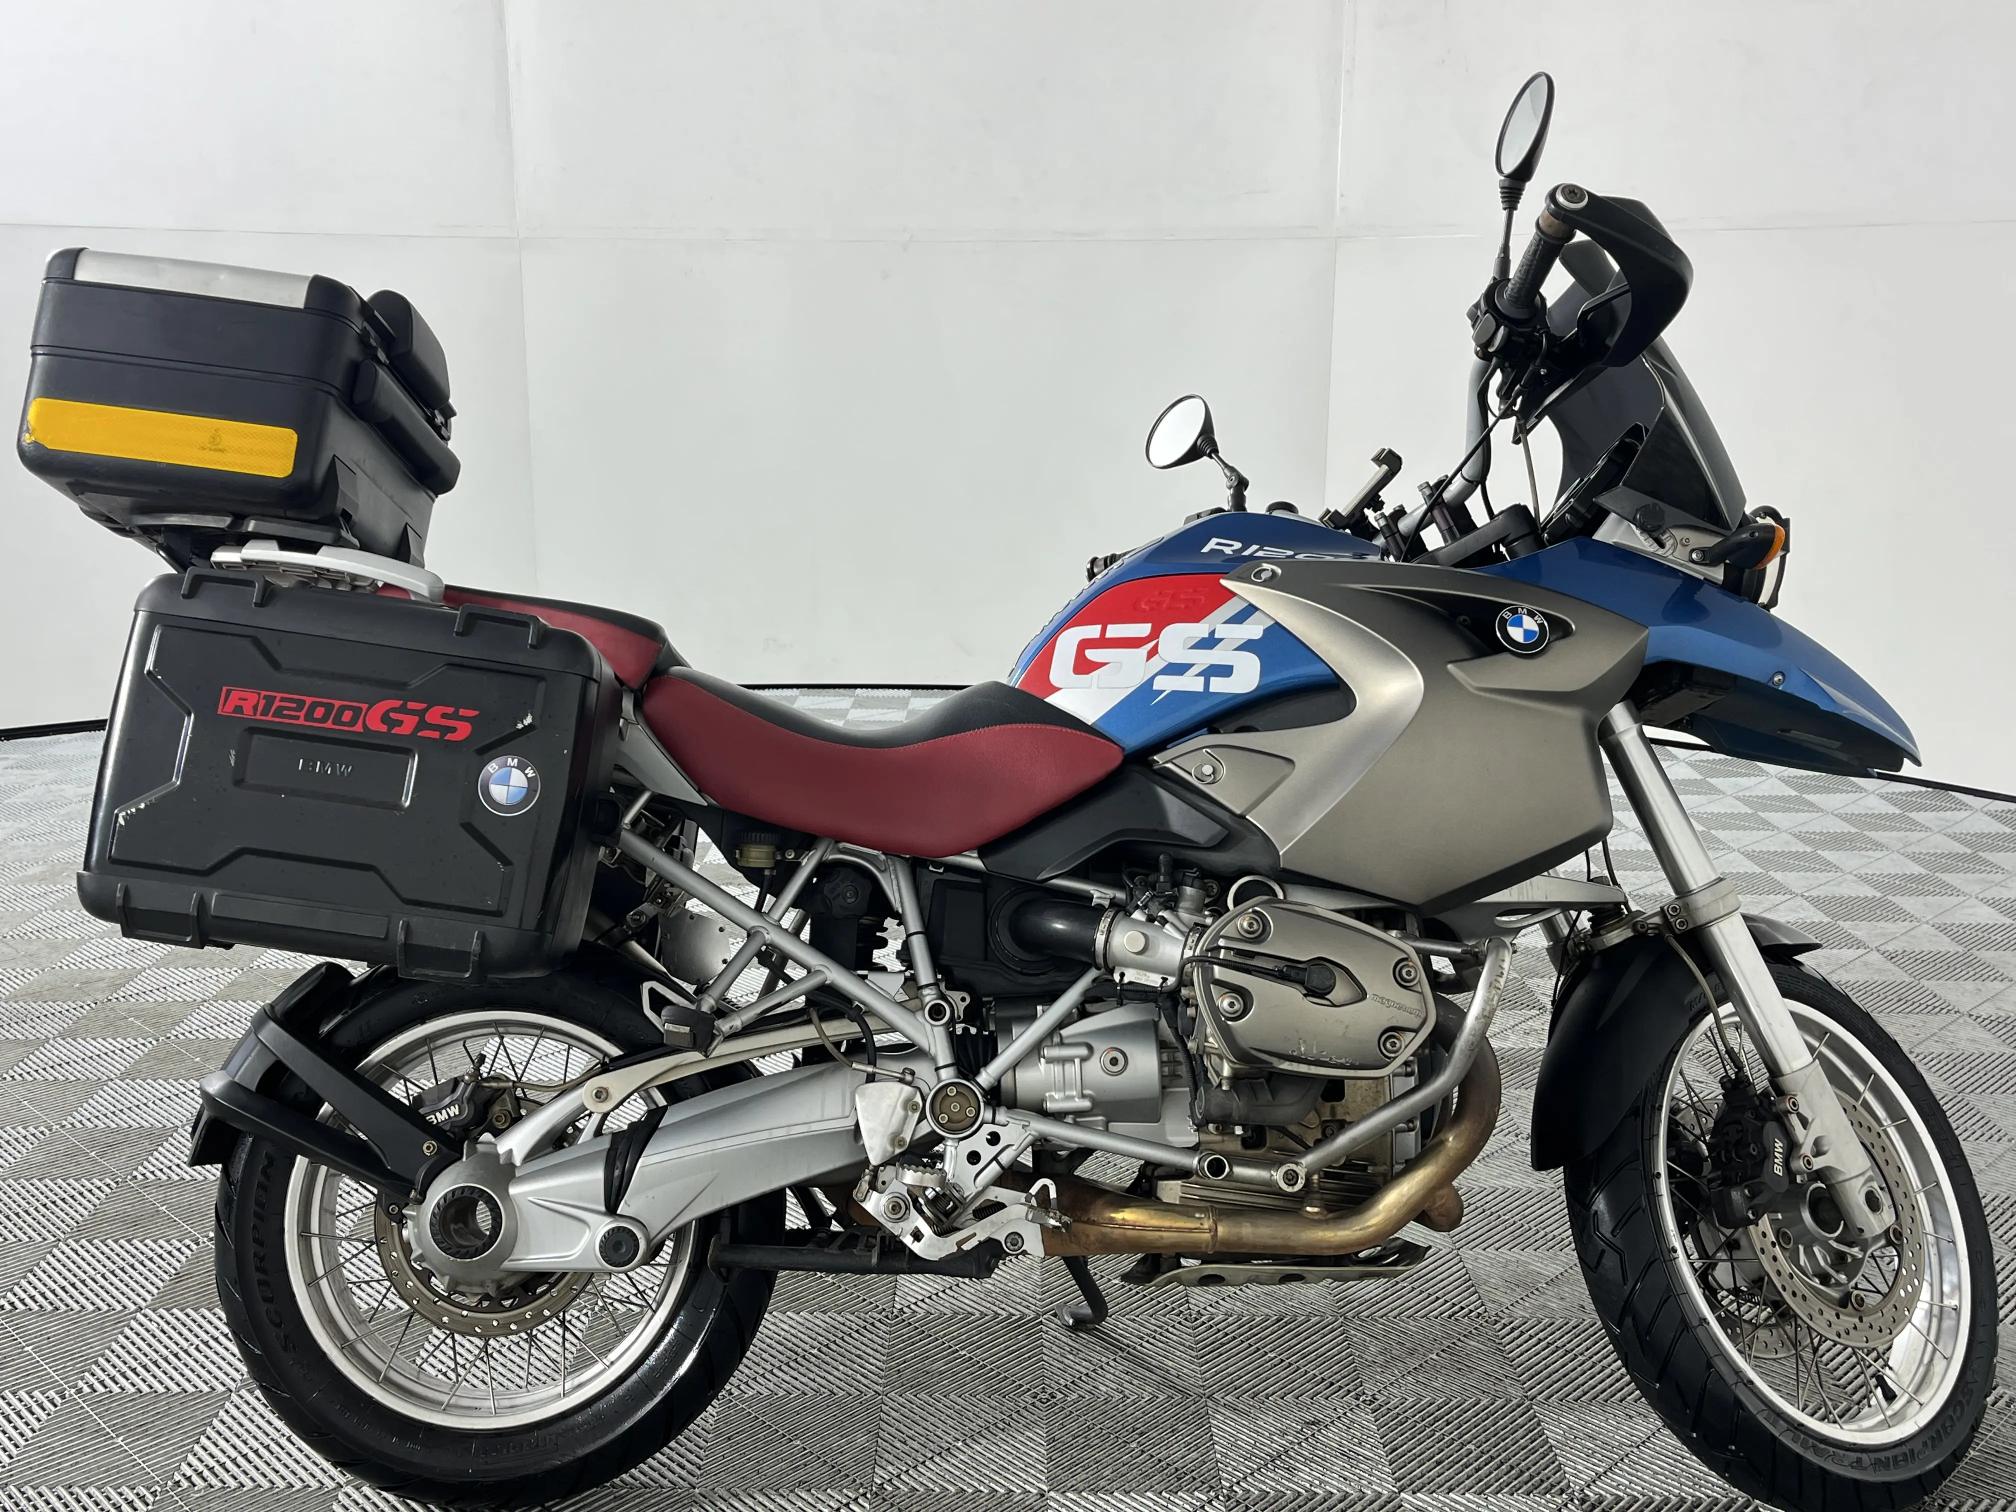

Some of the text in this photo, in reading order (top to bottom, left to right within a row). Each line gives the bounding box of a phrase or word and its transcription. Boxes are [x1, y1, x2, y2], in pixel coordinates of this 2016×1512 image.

[1502, 608, 1544, 624] BMW
[1049, 622, 1264, 694] GS
[487, 757, 536, 778] BMW
[1773, 1138, 1784, 1177] BMW
